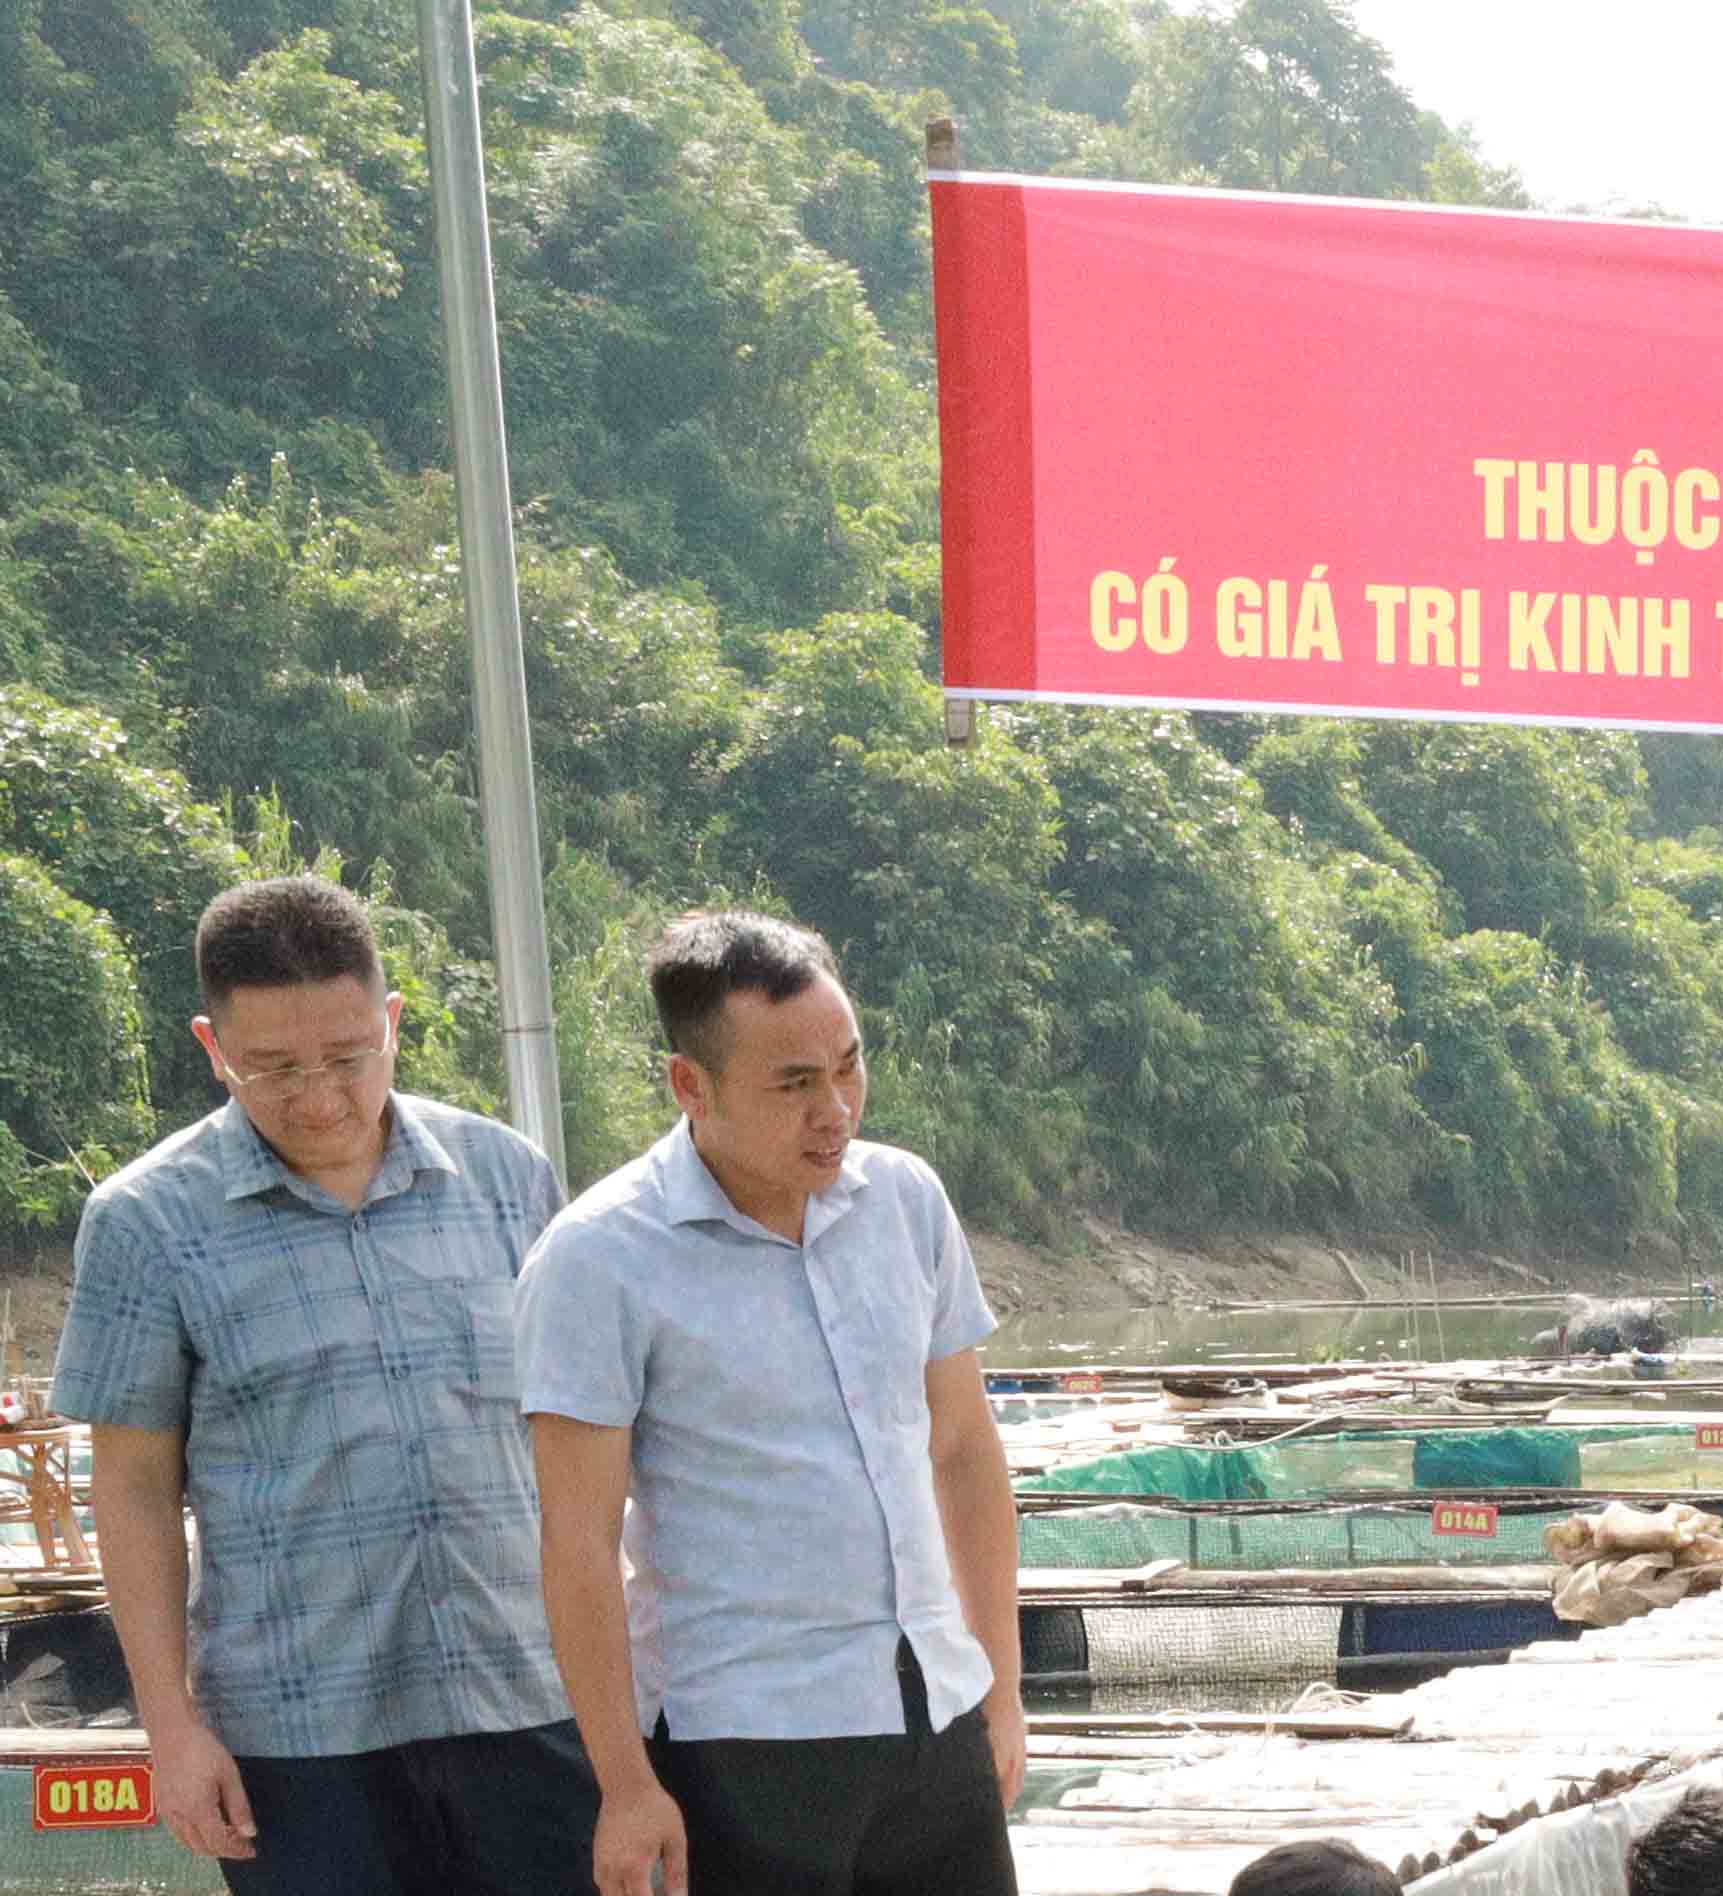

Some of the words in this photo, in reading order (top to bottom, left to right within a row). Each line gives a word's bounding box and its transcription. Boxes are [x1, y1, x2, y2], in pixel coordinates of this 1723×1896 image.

[1472, 446, 1722, 564] THUỘC
[1088, 553, 1190, 656] CÓ
[1214, 563, 1345, 661] GIÁ
[1364, 582, 1482, 687] TRỊ
[1507, 590, 1692, 678] KINH
[1440, 1510, 1490, 1531] 014A
[48, 1773, 140, 1814] 018A
